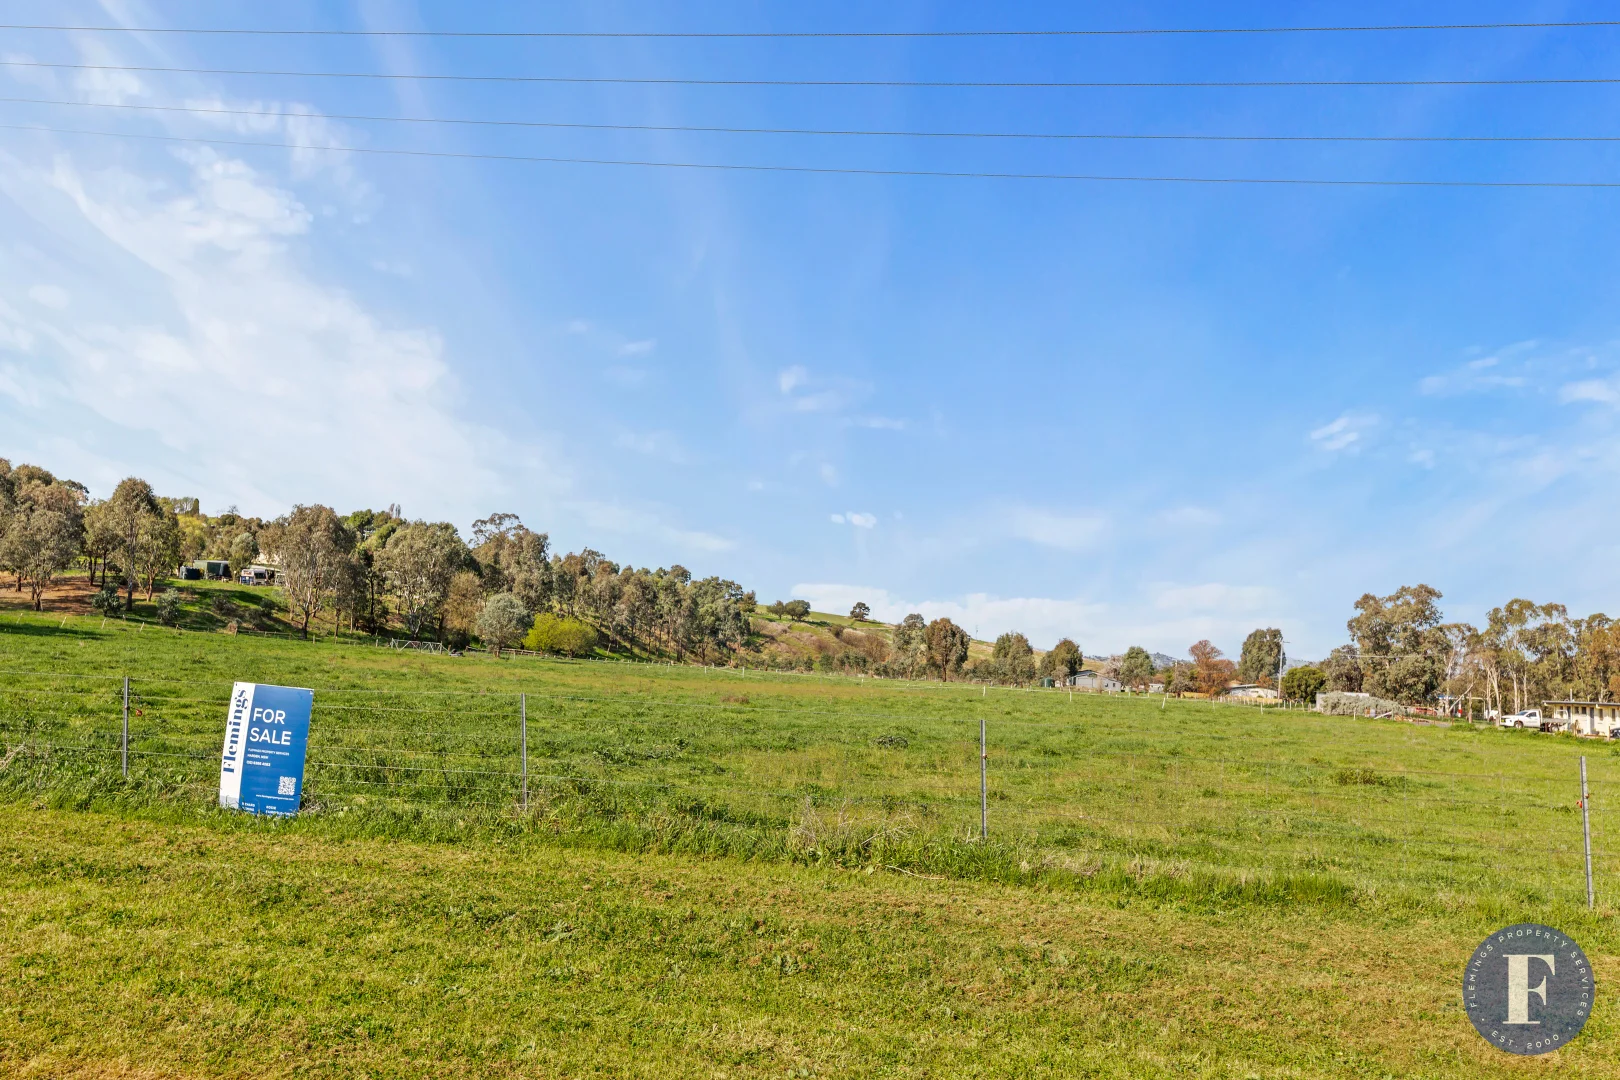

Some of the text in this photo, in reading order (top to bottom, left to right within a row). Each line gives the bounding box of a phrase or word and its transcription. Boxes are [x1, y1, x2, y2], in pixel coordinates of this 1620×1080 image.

[253, 708, 286, 724] FOR
[223, 690, 248, 773] Flemings
[250, 728, 291, 745] SALE
